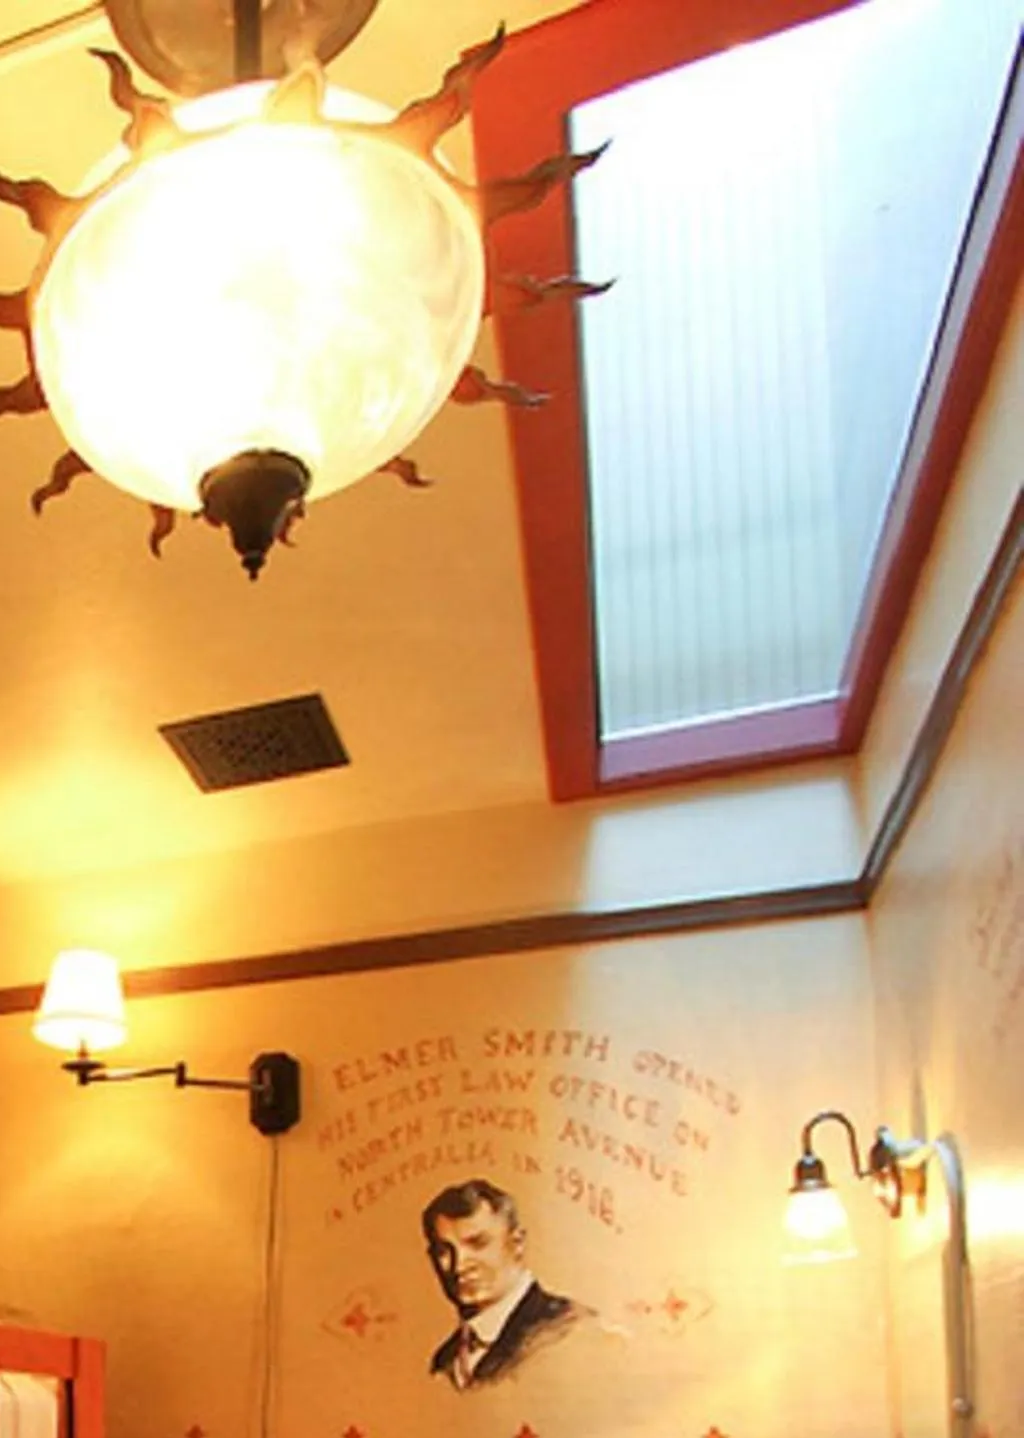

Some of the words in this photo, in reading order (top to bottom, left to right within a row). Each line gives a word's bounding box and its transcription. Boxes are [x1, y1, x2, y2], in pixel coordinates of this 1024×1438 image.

[331, 1034, 459, 1095] ELMER
[482, 1028, 611, 1063] SMITH
[460, 1067, 535, 1095] LAW
[548, 1073, 662, 1128] OFFICE
[336, 1115, 424, 1183] NORTH
[437, 1106, 540, 1138] TOWER
[557, 1116, 689, 1197] AVENUE
[351, 1140, 499, 1215] CENTRALIA
